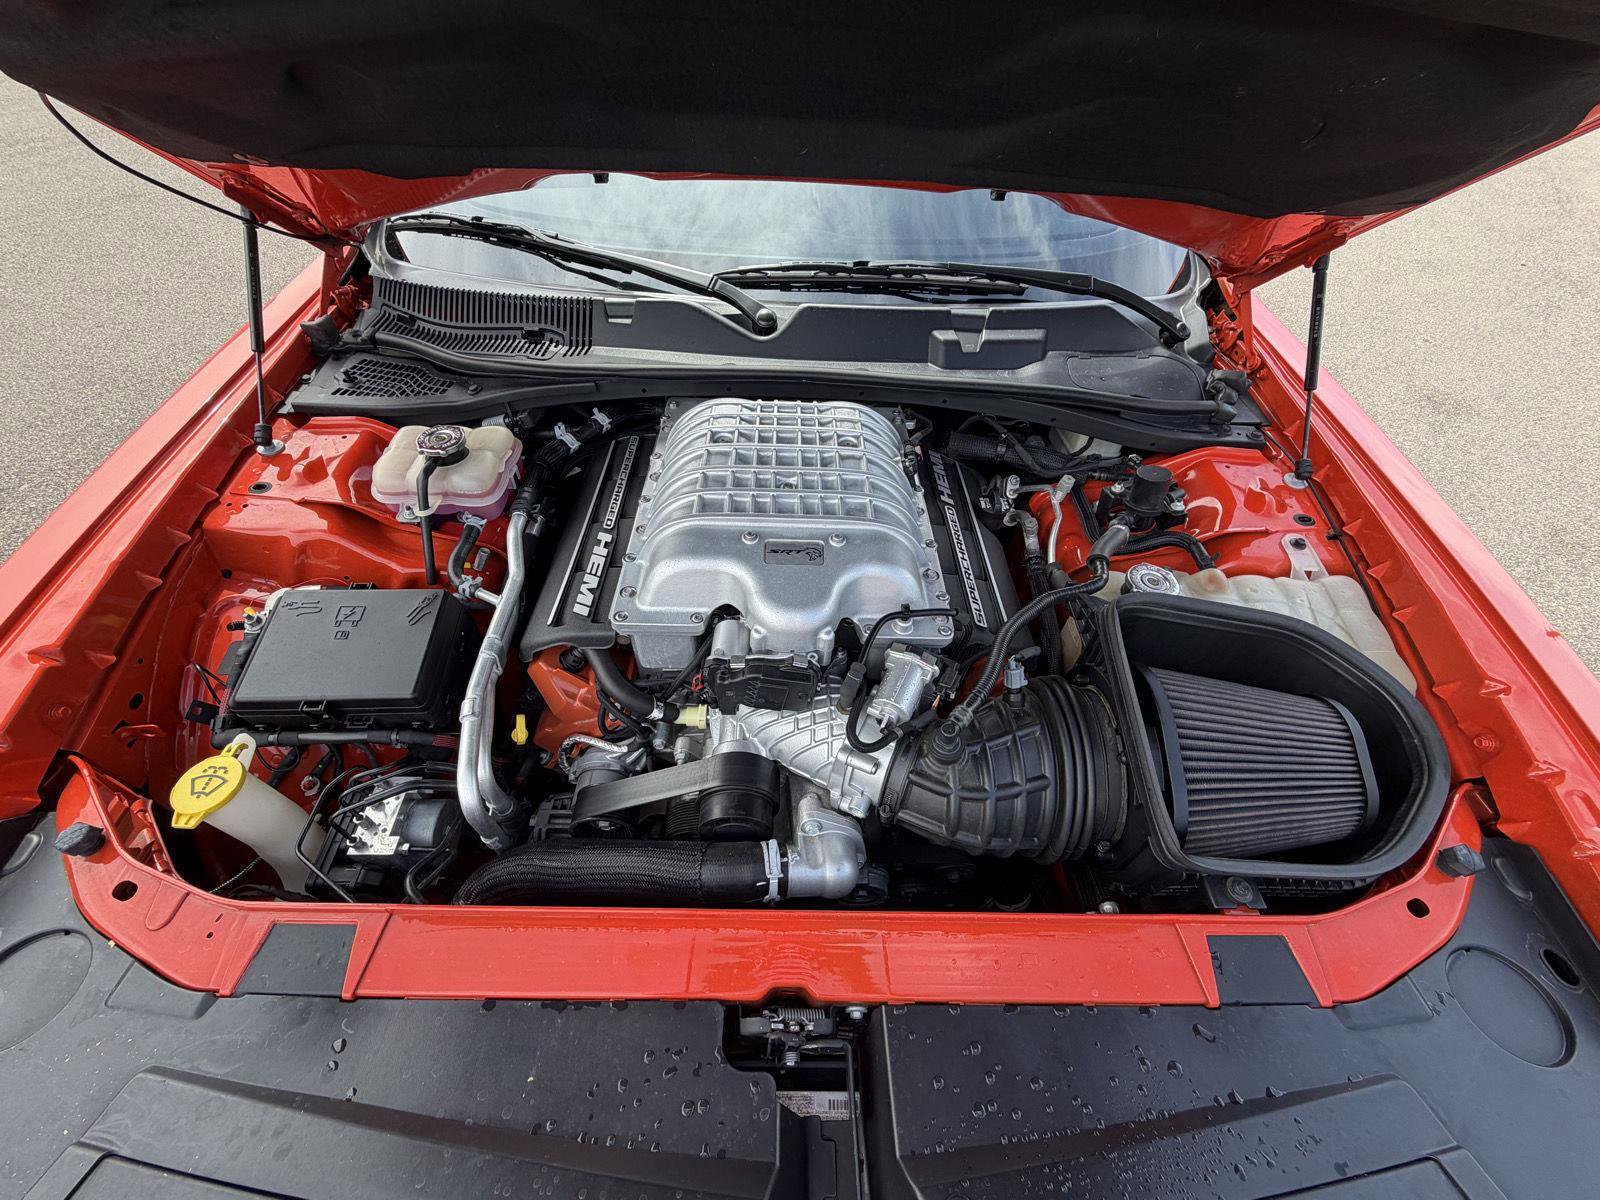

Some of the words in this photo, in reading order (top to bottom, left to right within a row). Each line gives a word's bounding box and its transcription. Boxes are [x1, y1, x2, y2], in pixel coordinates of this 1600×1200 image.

[605, 436, 639, 528] SUPERCHARGED
[928, 450, 955, 506] HEMI
[573, 532, 613, 617] HEMI
[946, 507, 986, 627] SUPERCHARGED
